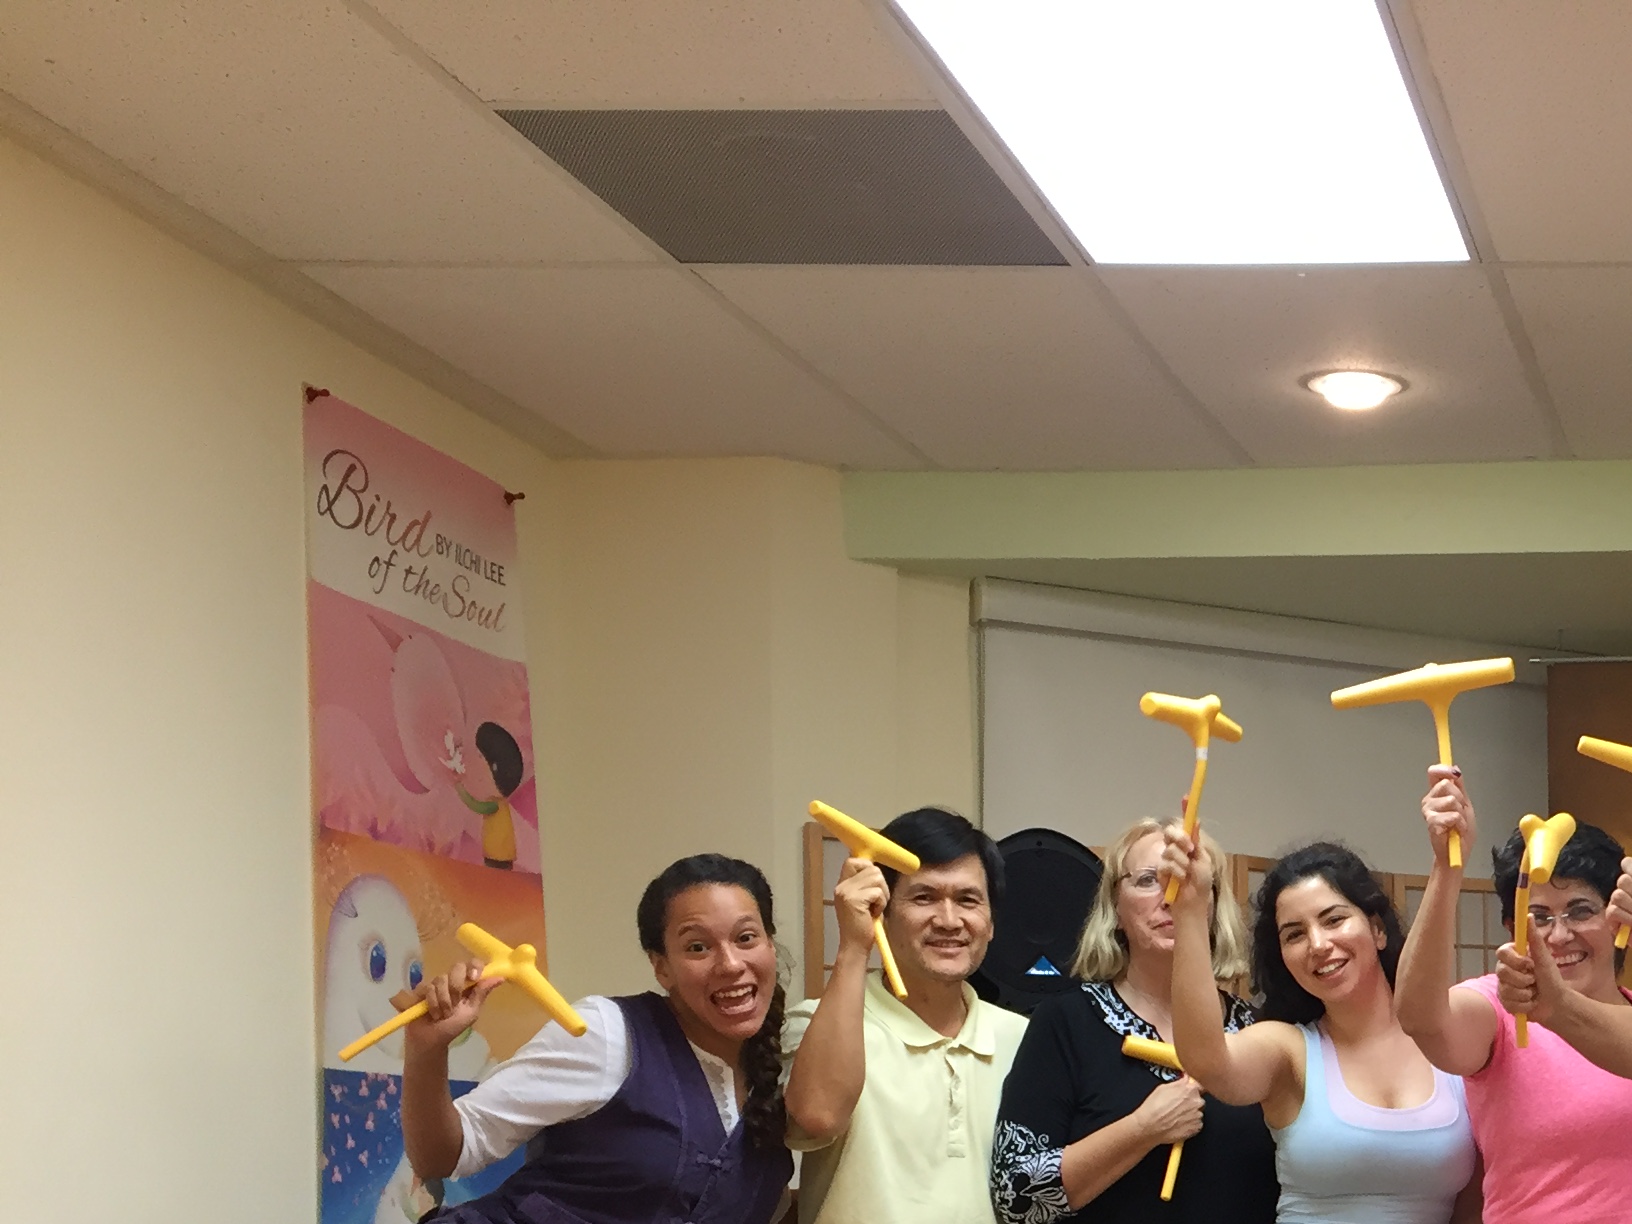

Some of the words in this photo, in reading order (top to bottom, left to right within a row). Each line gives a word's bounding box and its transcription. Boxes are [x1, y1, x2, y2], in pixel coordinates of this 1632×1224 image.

[317, 449, 433, 558] Bird
[368, 549, 398, 594] of
[403, 565, 442, 605] the
[442, 574, 506, 632] Soul
[436, 533, 452, 559] BY
[455, 543, 481, 576] ILCHI
[484, 559, 506, 586] LEE
